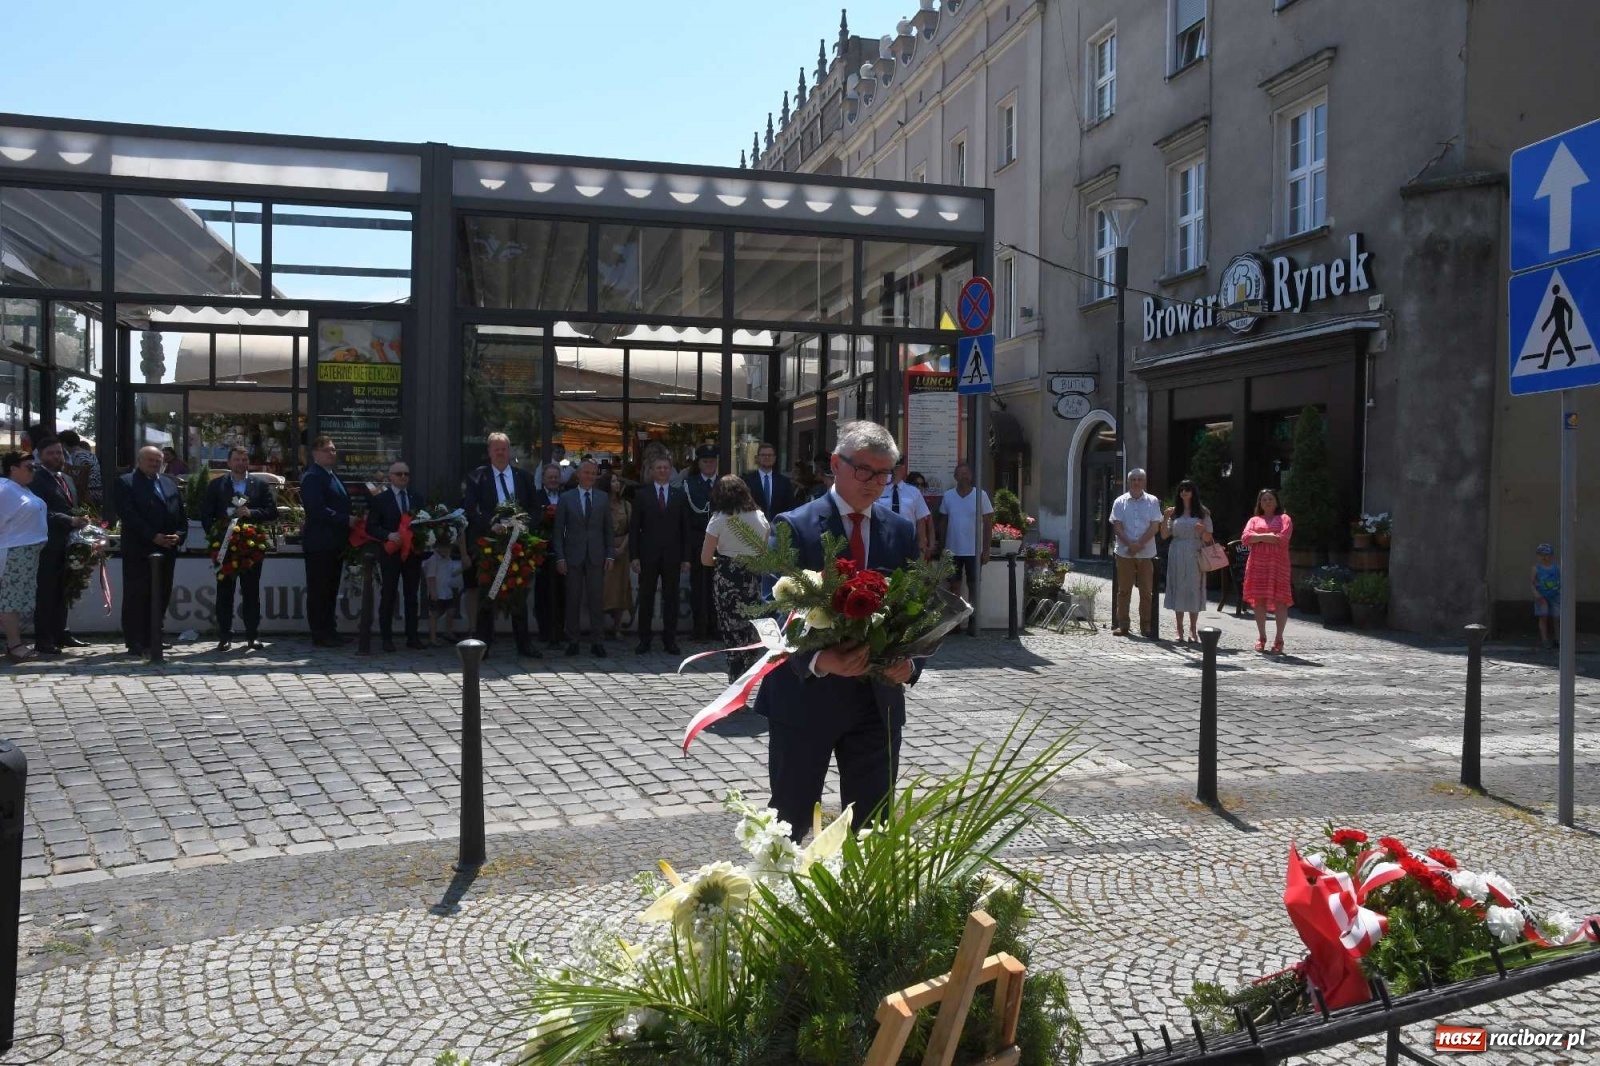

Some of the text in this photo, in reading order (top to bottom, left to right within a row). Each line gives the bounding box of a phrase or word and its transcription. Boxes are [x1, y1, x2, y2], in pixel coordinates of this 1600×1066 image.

[1143, 233, 1368, 342] Browar Rynek
[320, 365, 399, 381] CATERING DIETETYCZNY
[915, 376, 953, 386] LUNCH
[353, 386, 398, 396] BEZ PSZENICY
